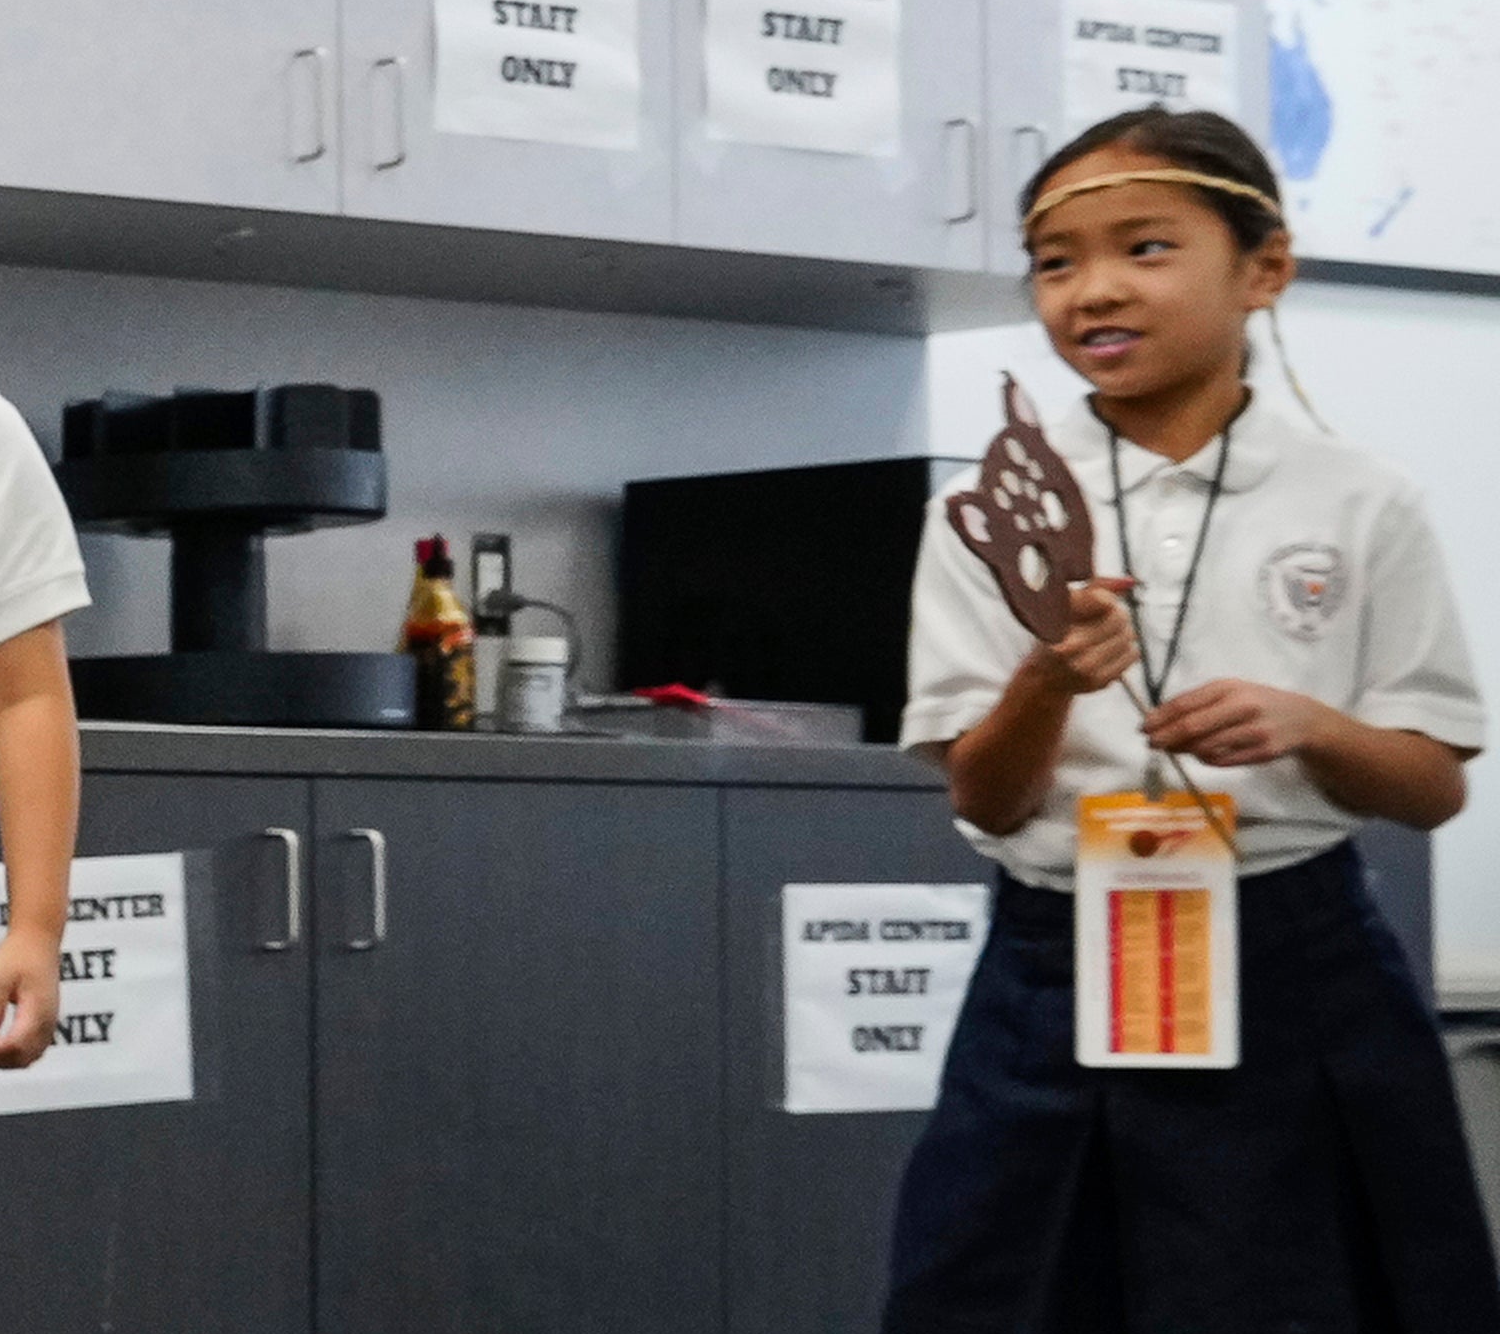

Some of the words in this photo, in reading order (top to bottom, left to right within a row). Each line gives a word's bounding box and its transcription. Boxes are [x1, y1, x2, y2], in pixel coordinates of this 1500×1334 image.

[761, 10, 844, 45] STAFF
[1144, 28, 1223, 55] CENTER
[500, 54, 579, 89] ONLY
[766, 65, 839, 99] ONLY
[1116, 67, 1187, 98] STAFF
[68, 893, 165, 922] ENTER
[802, 919, 870, 942] APIDA
[878, 919, 972, 942] CENTER
[59, 948, 116, 982] AFF
[847, 967, 930, 996] STAFF
[50, 1012, 114, 1046] NLY
[851, 1024, 924, 1053] ONLY
